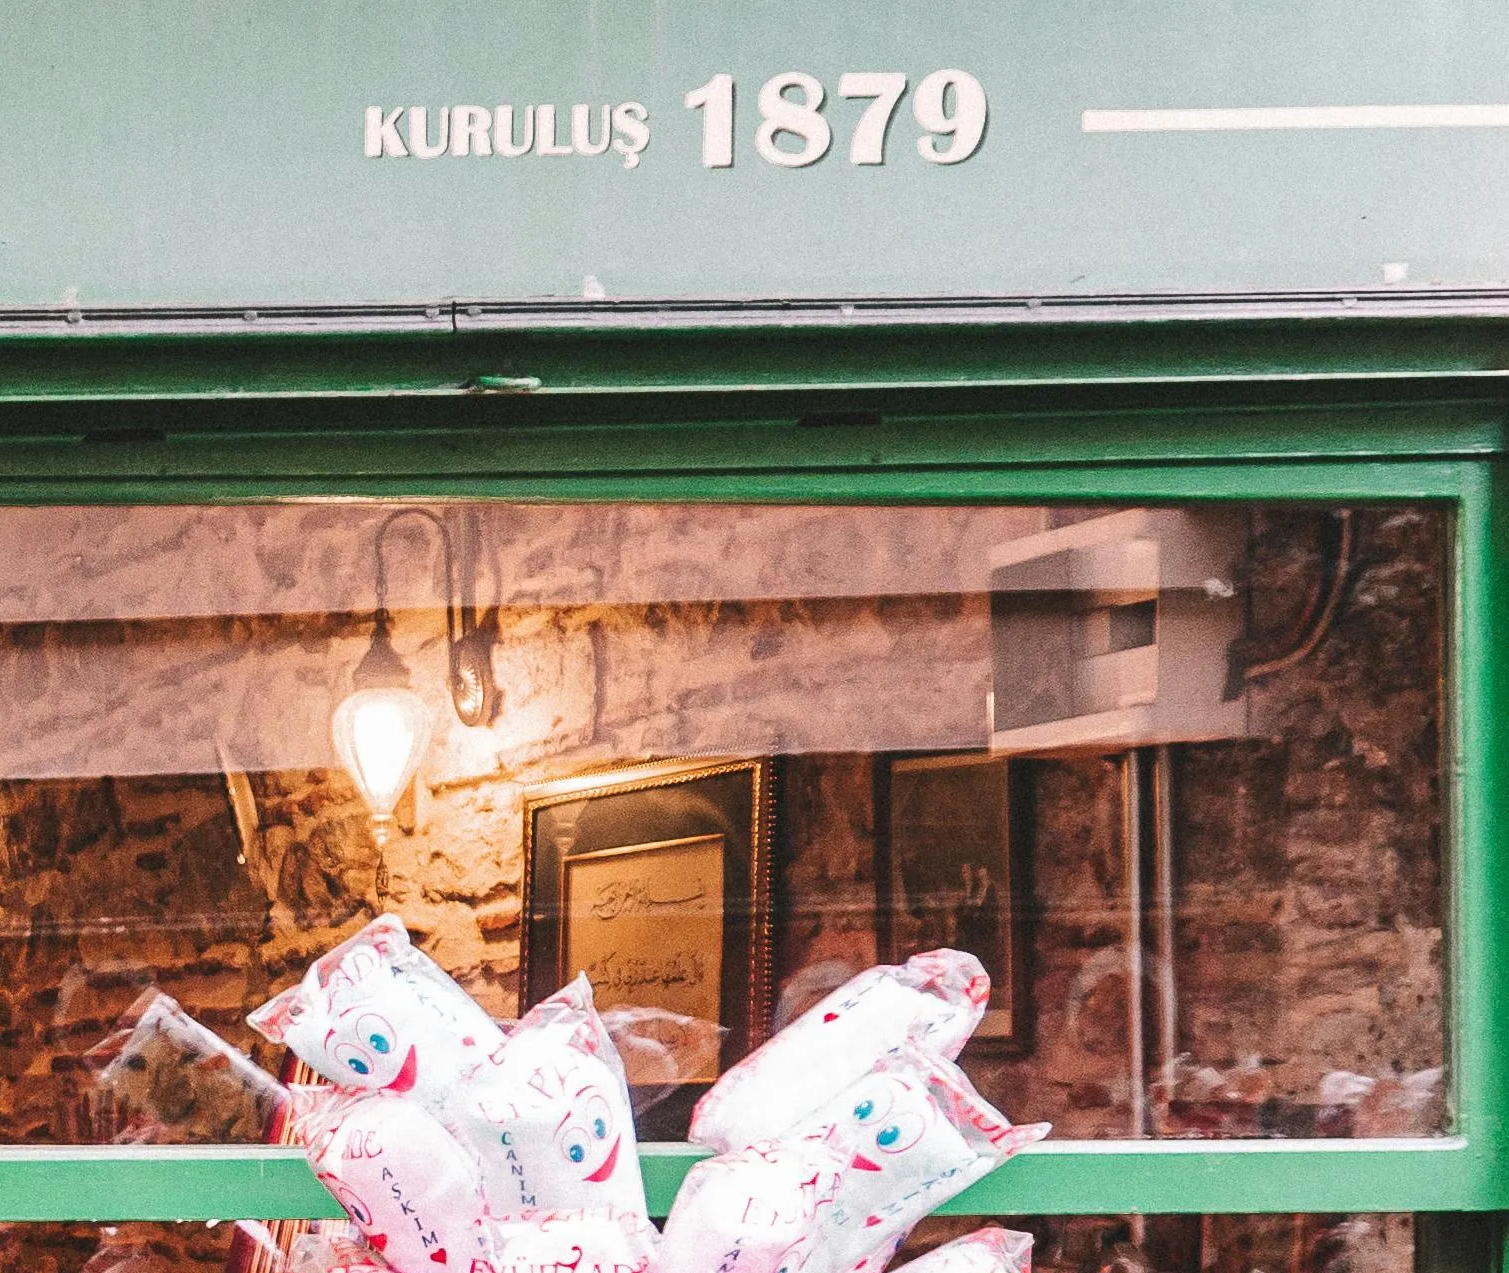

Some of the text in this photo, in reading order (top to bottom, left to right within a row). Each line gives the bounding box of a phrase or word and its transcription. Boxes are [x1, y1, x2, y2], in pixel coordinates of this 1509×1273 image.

[364, 69, 988, 168] KURULUŞ 1879
[500, 1131, 536, 1206] CANIM
